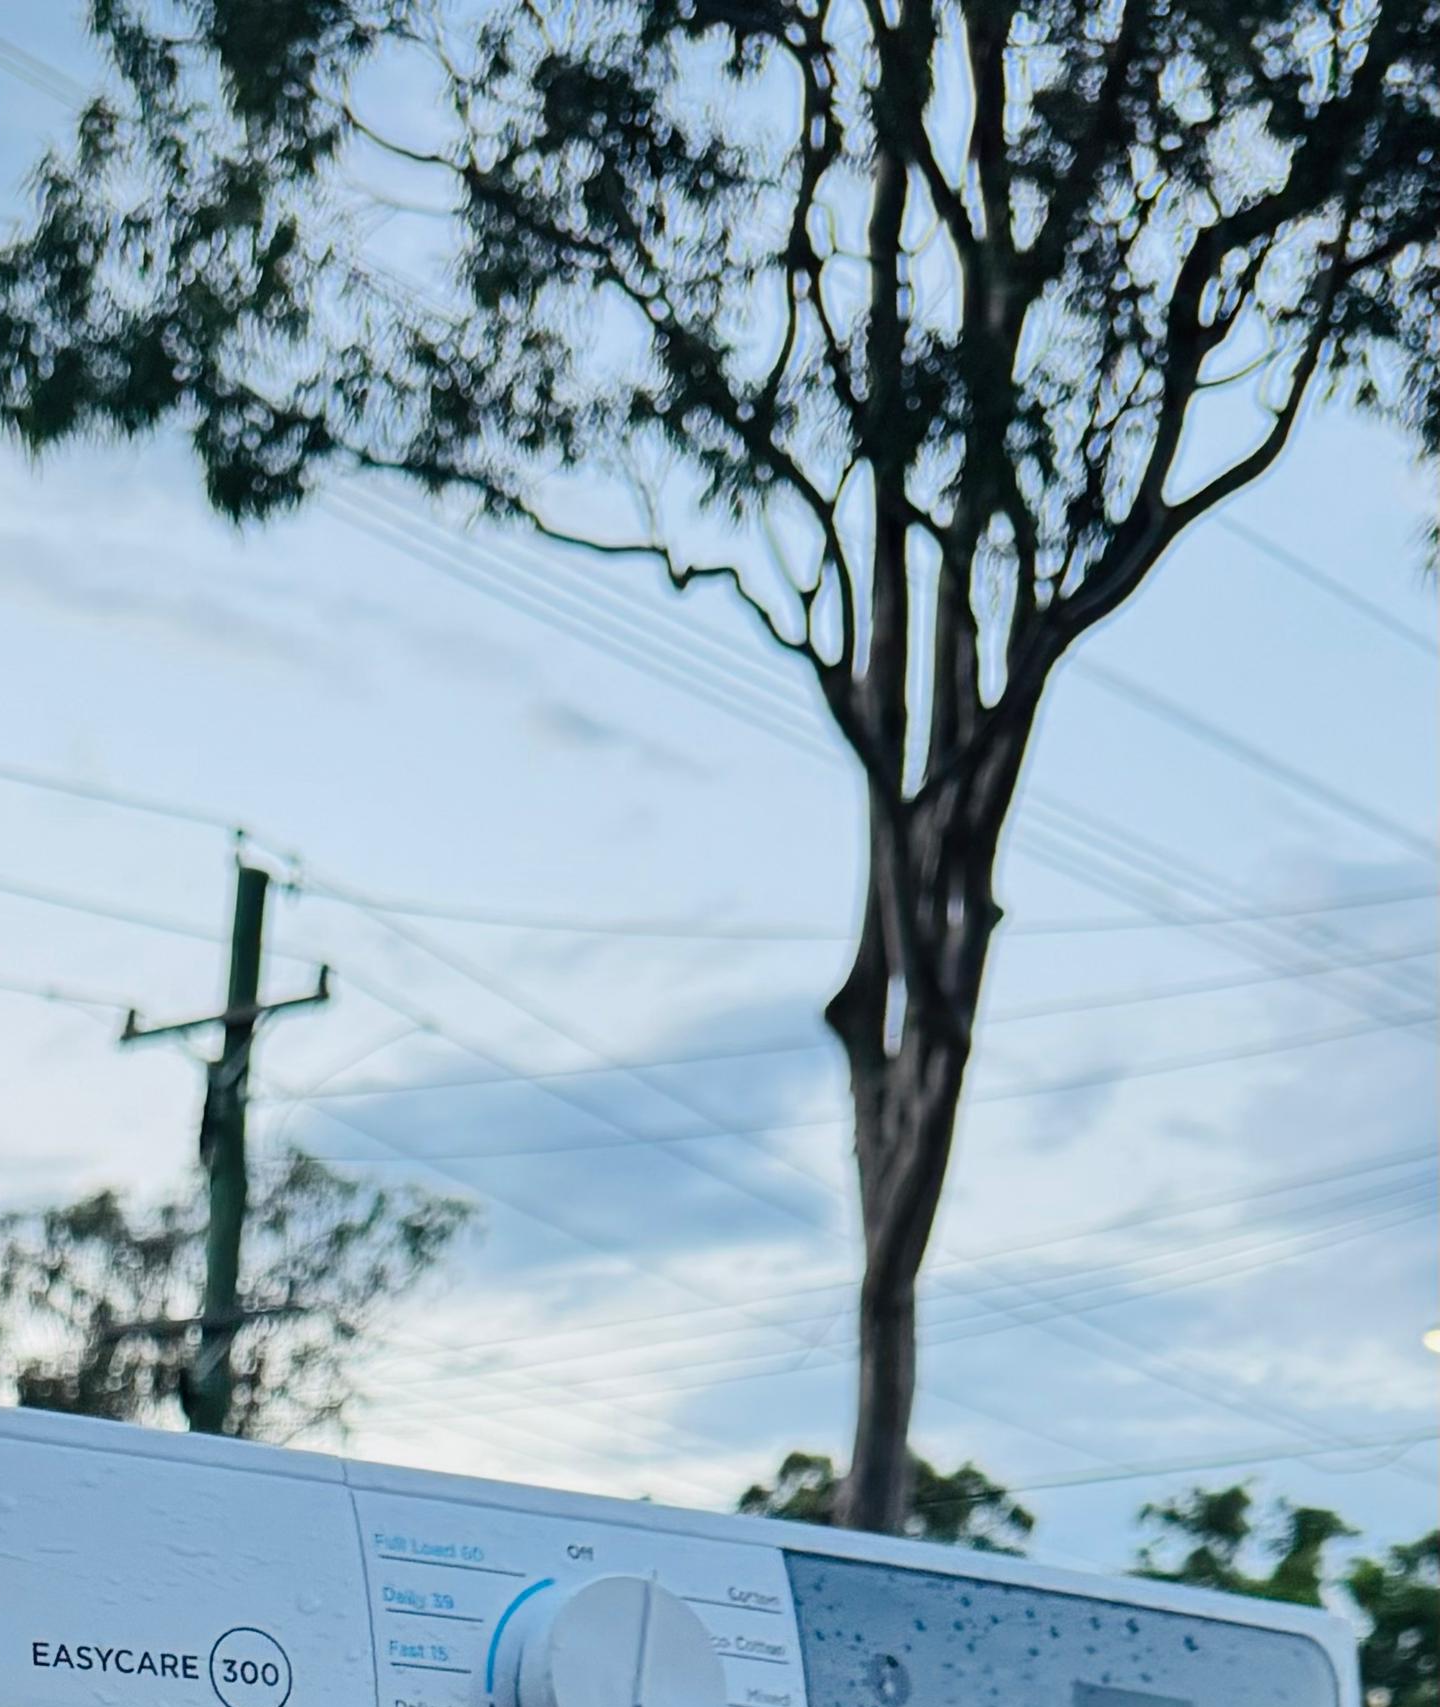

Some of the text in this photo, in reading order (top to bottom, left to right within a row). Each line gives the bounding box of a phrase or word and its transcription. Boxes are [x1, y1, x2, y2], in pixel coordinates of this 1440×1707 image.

[412, 1538, 456, 1559] Load
[566, 1544, 594, 1561] Off
[382, 1587, 427, 1610] Daily
[389, 1640, 424, 1658] Fast
[31, 1641, 281, 1688] EASYCARE 300
